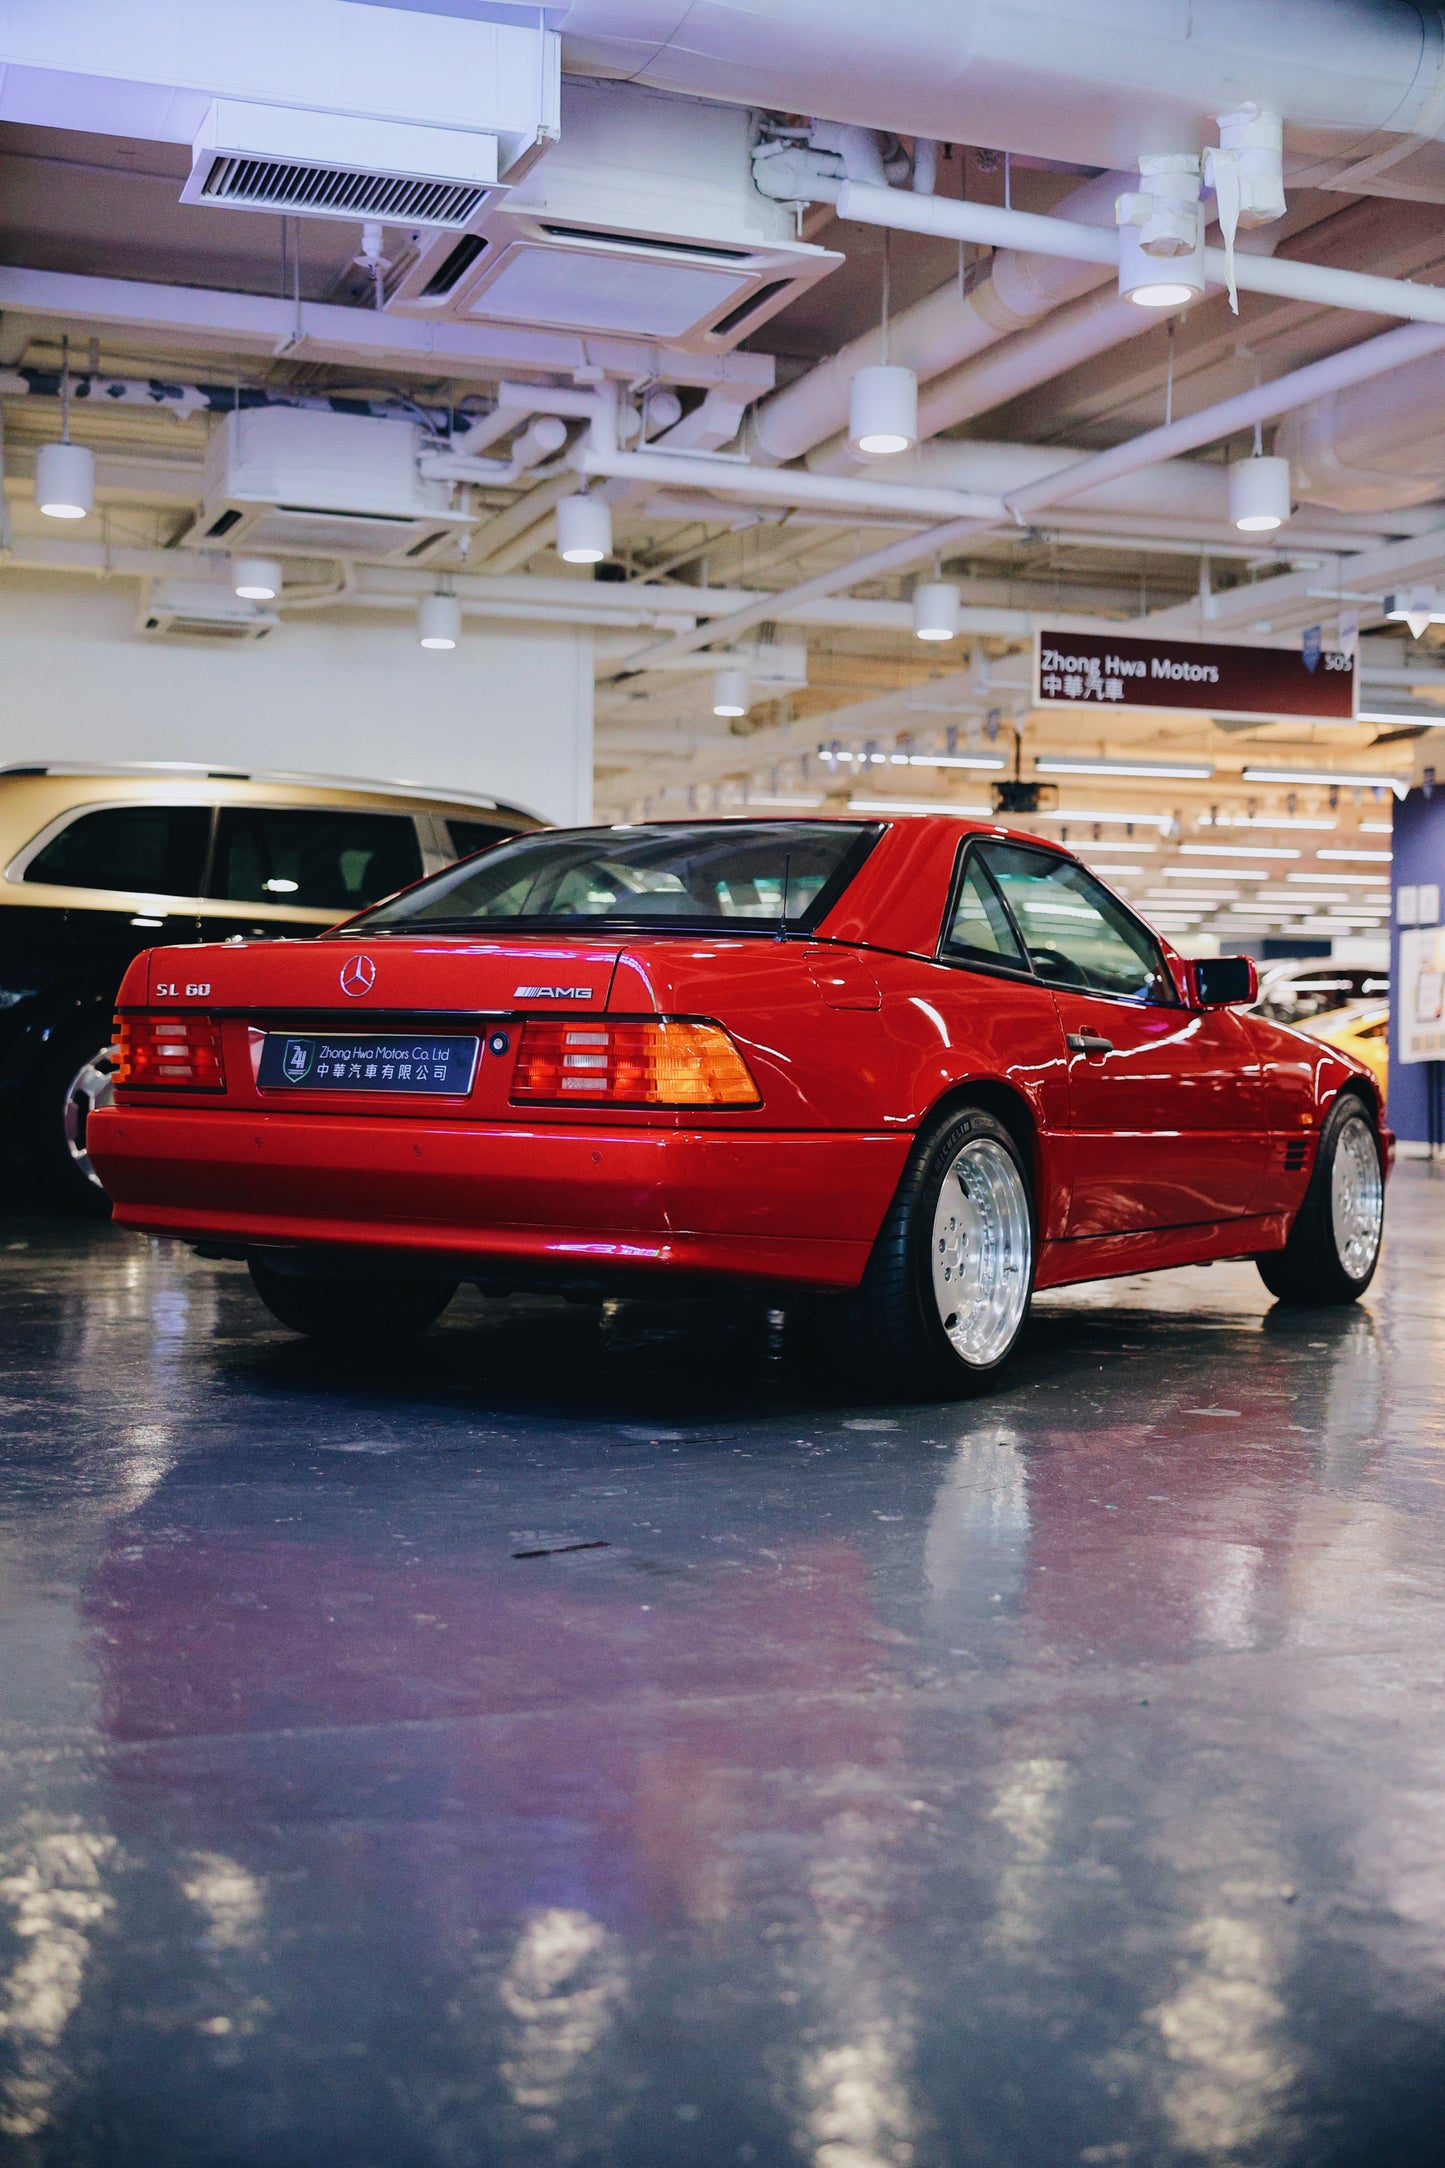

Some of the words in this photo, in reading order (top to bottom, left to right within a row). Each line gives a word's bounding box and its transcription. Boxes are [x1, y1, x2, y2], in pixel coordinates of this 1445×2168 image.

[1041, 649, 1101, 678] Zhong
[1105, 654, 1147, 678] Hwa
[1151, 657, 1219, 683] Motors
[1042, 672, 1125, 701] 中華汽車
[156, 983, 180, 997] SL
[185, 983, 211, 997] 60
[536, 986, 593, 999] AMG
[319, 1045, 351, 1060] Zhong
[352, 1046, 374, 1059] Hwa
[375, 1046, 410, 1060] Motors
[411, 1046, 430, 1060] Co.
[432, 1047, 450, 1061] Ltd
[316, 1062, 447, 1081] 中華汽車有限公司
